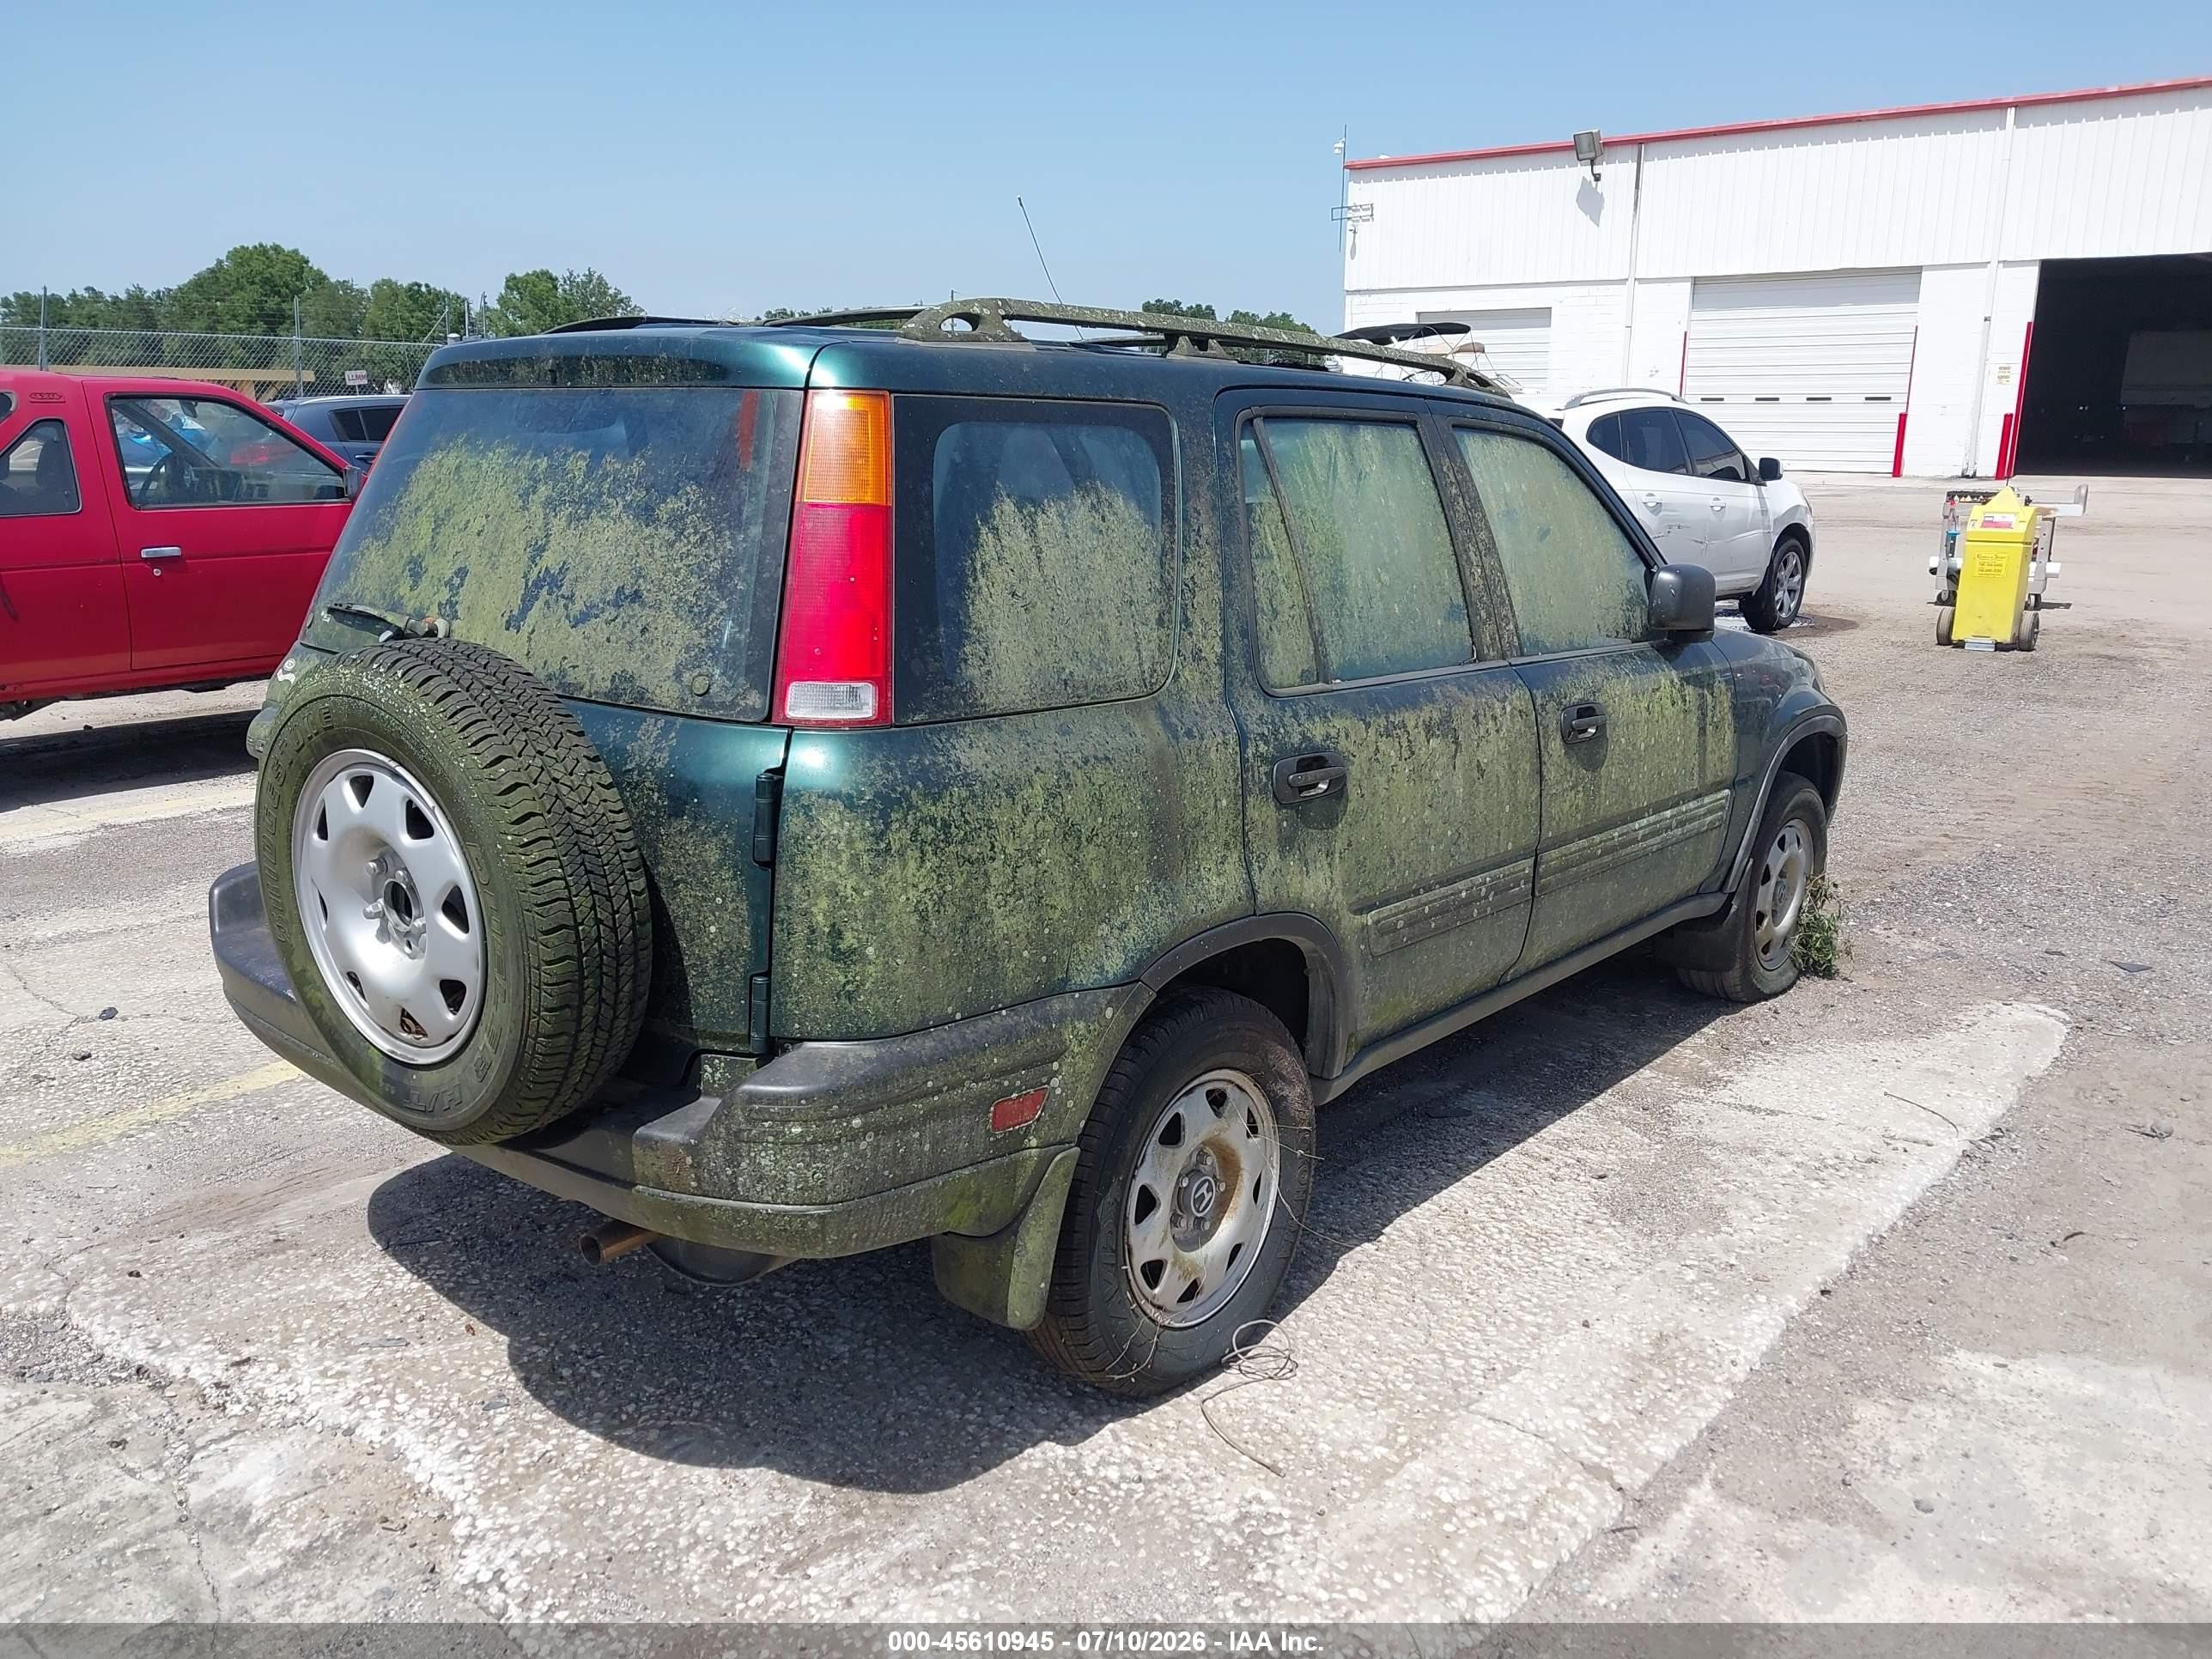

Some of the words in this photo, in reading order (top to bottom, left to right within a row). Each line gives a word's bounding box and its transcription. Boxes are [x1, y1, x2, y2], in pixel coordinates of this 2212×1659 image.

[260, 704, 334, 942] BRIDGESTONE
[466, 842, 507, 1083] DUELER
[404, 1080, 462, 1113] H/T
